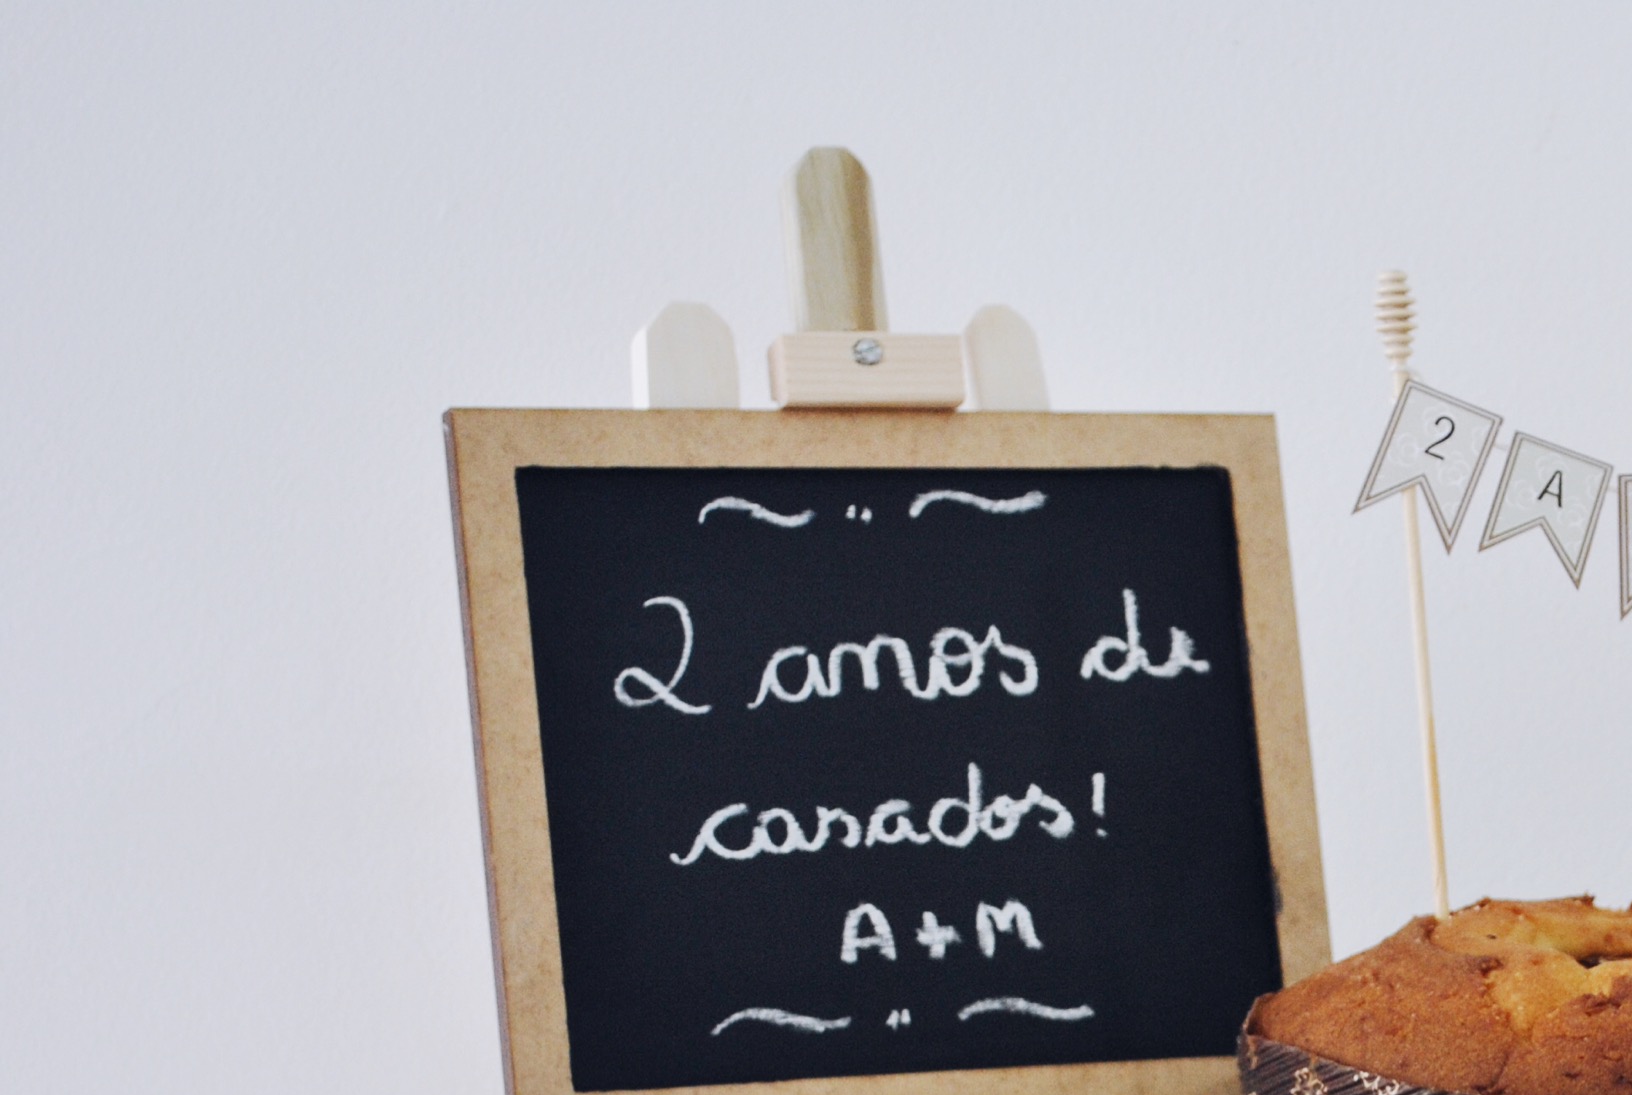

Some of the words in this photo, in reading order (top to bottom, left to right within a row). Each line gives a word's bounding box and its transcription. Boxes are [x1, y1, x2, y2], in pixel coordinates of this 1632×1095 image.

[1424, 415, 1456, 461] 2
[614, 597, 711, 714] 2
[748, 625, 1038, 710] anos
[1081, 588, 1210, 681] de
[670, 762, 1107, 865] casados!
